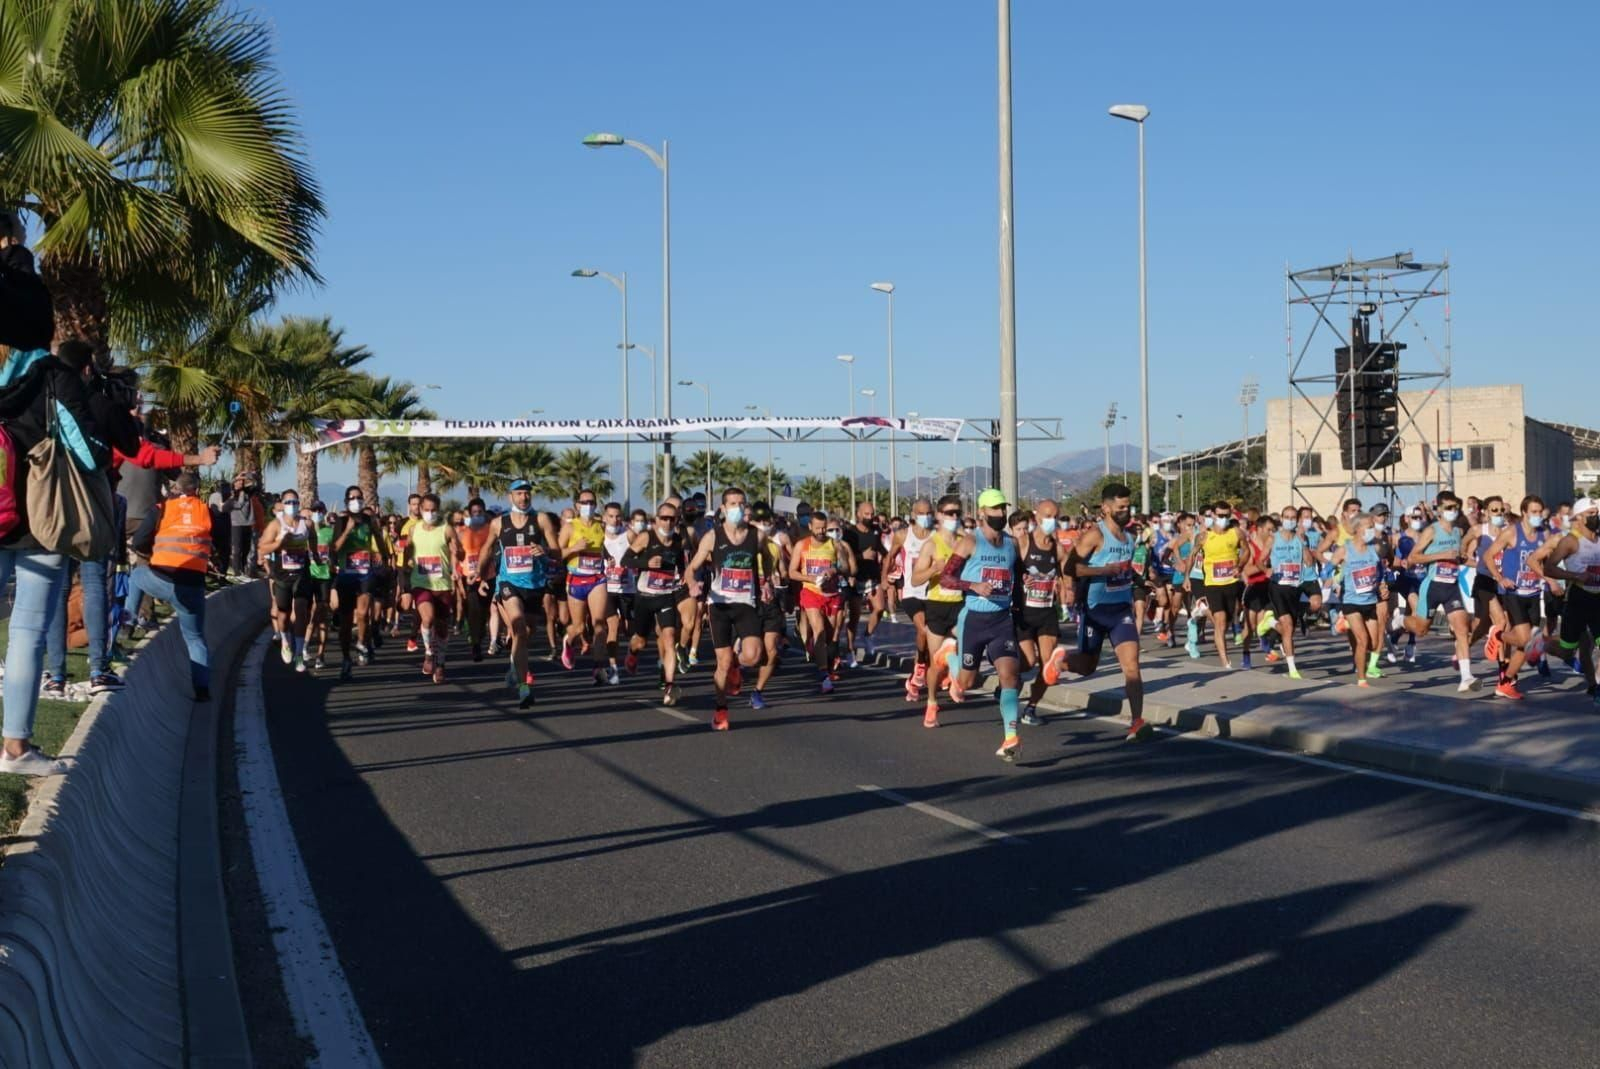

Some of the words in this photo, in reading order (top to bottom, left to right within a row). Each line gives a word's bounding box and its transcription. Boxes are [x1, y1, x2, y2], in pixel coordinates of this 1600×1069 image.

[445, 419, 496, 428] MEDIA
[586, 417, 681, 429] CAIXABANK
[981, 554, 1006, 564] nerja
